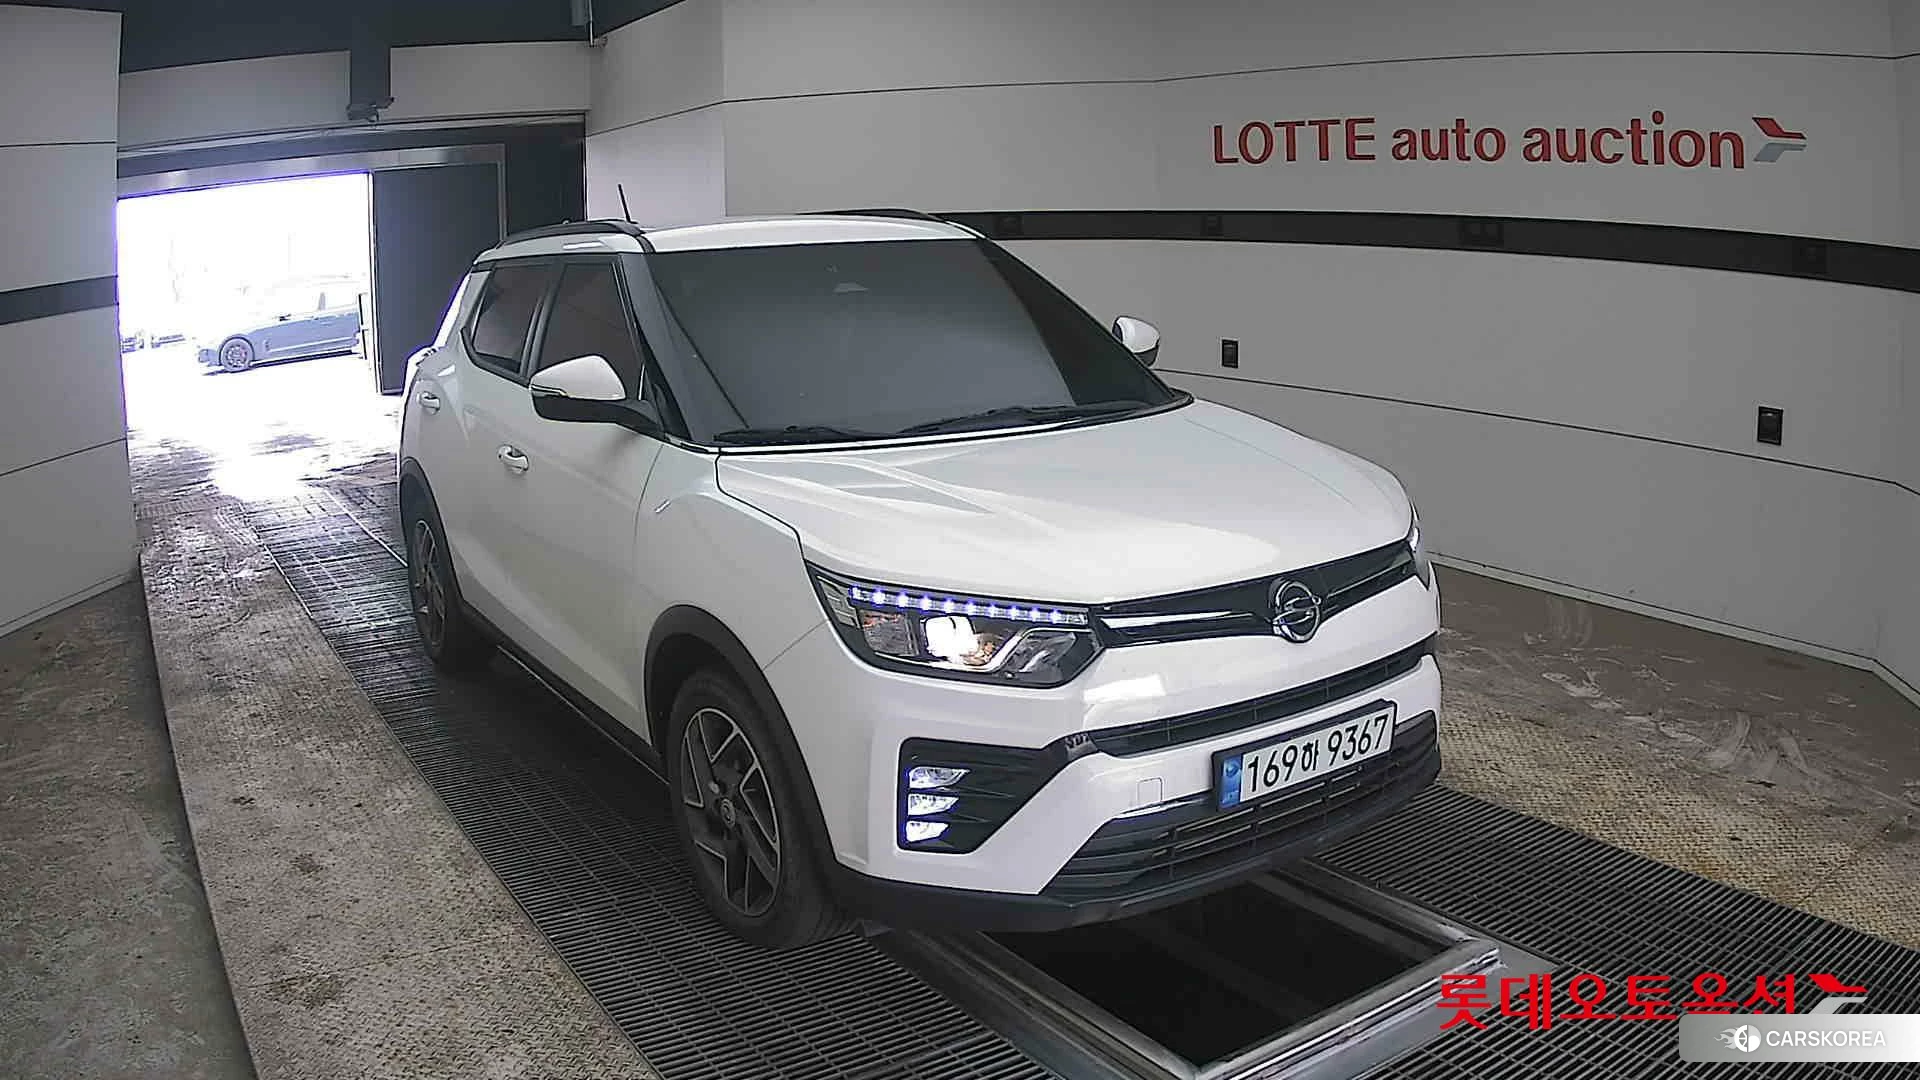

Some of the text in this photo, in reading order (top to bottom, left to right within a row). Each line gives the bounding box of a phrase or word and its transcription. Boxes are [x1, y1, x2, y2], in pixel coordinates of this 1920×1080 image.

[1213, 110, 1746, 169] LOTTE auto auction
[1247, 714, 1389, 792] 169하 9367
